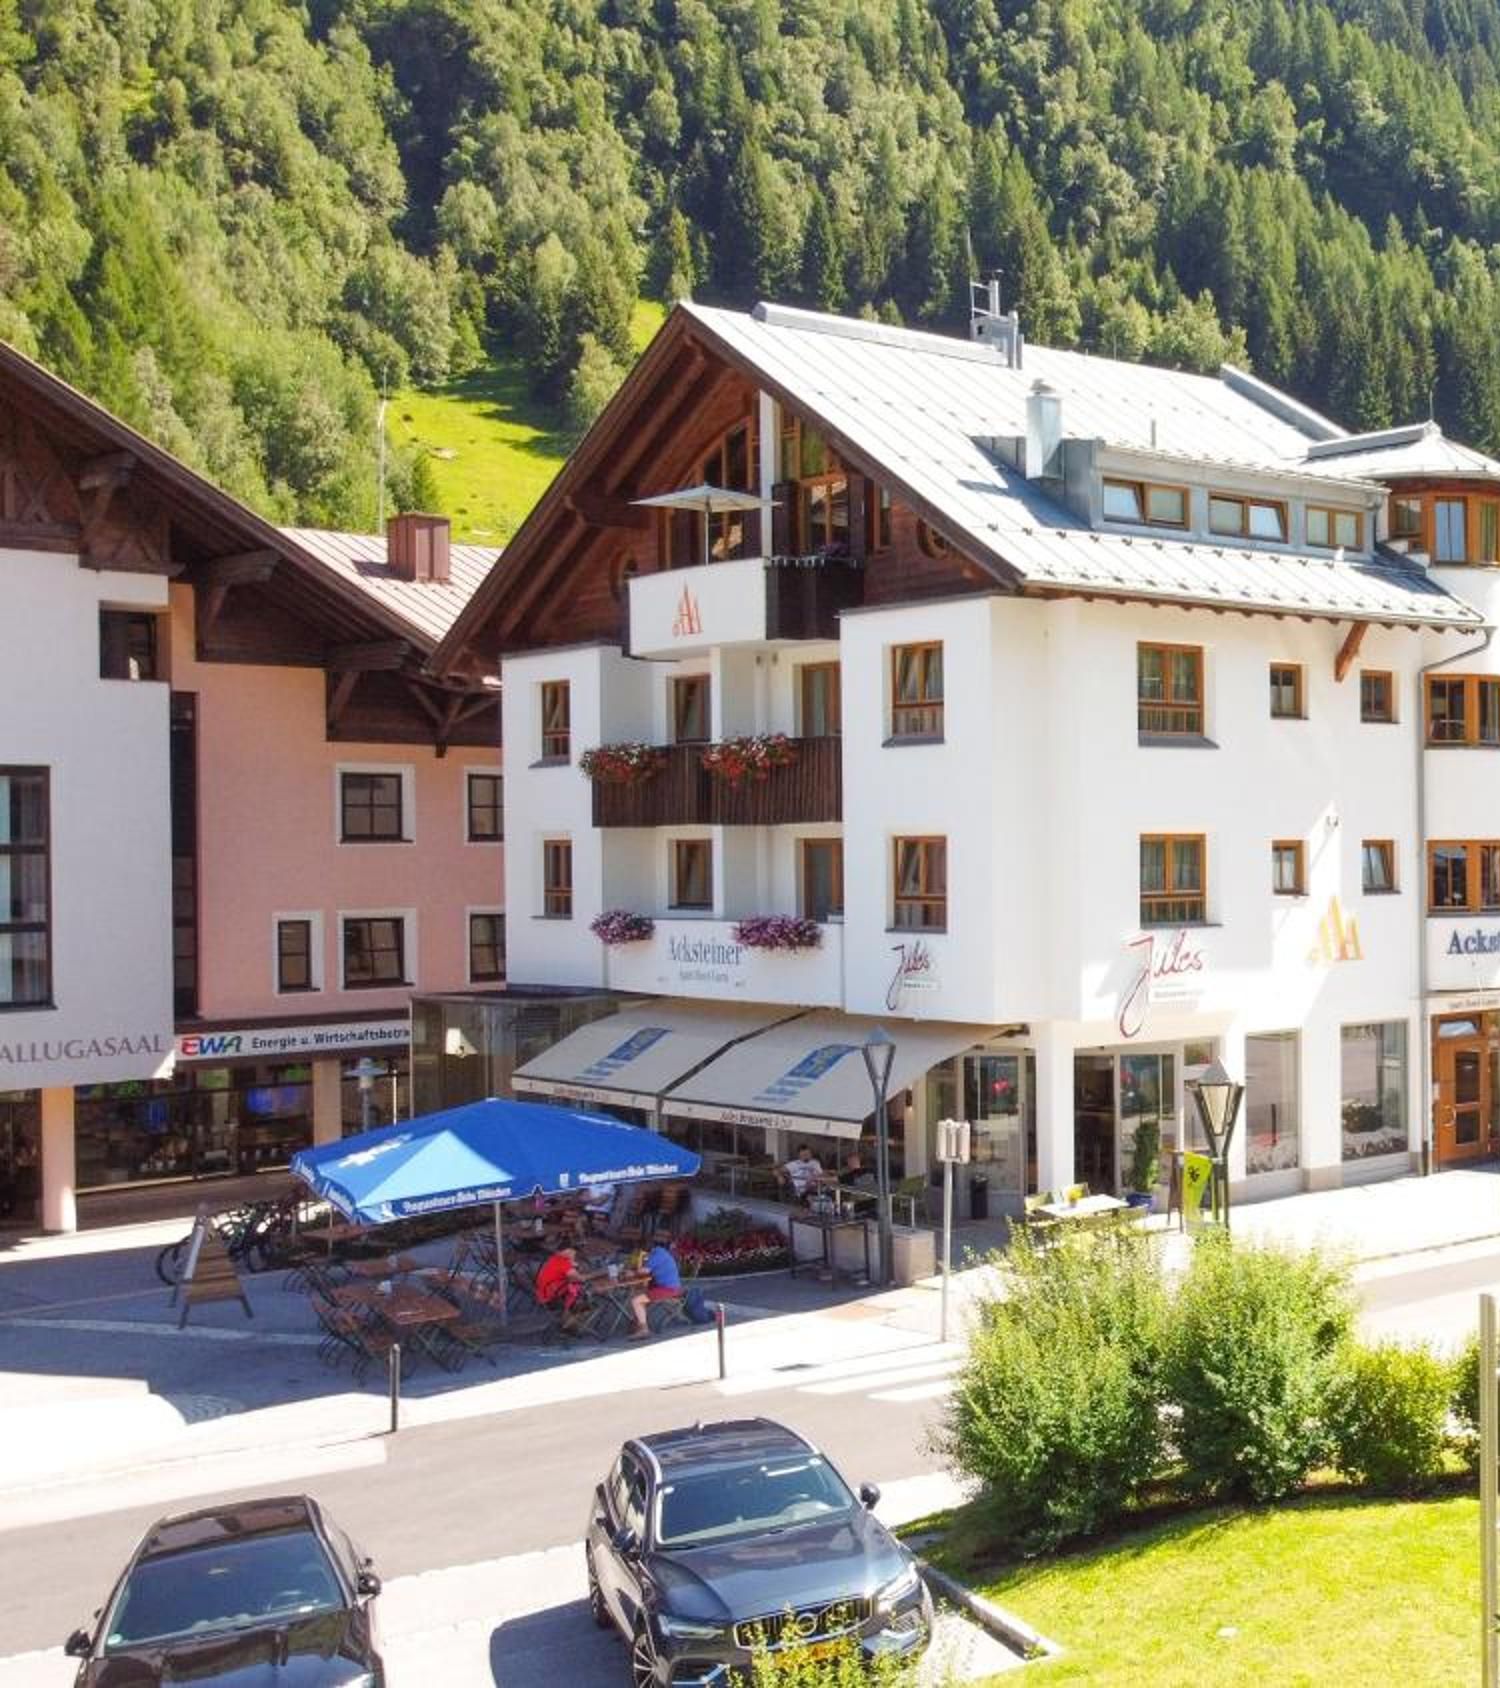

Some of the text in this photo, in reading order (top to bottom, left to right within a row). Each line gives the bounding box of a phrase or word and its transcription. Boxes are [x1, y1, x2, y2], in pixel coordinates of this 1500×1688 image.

[670, 936, 741, 966] Acksteiner
[886, 940, 930, 1011] Jules
[1120, 926, 1203, 1038] Jules
[181, 1036, 242, 1056] EWA
[252, 1033, 298, 1049] Energie
